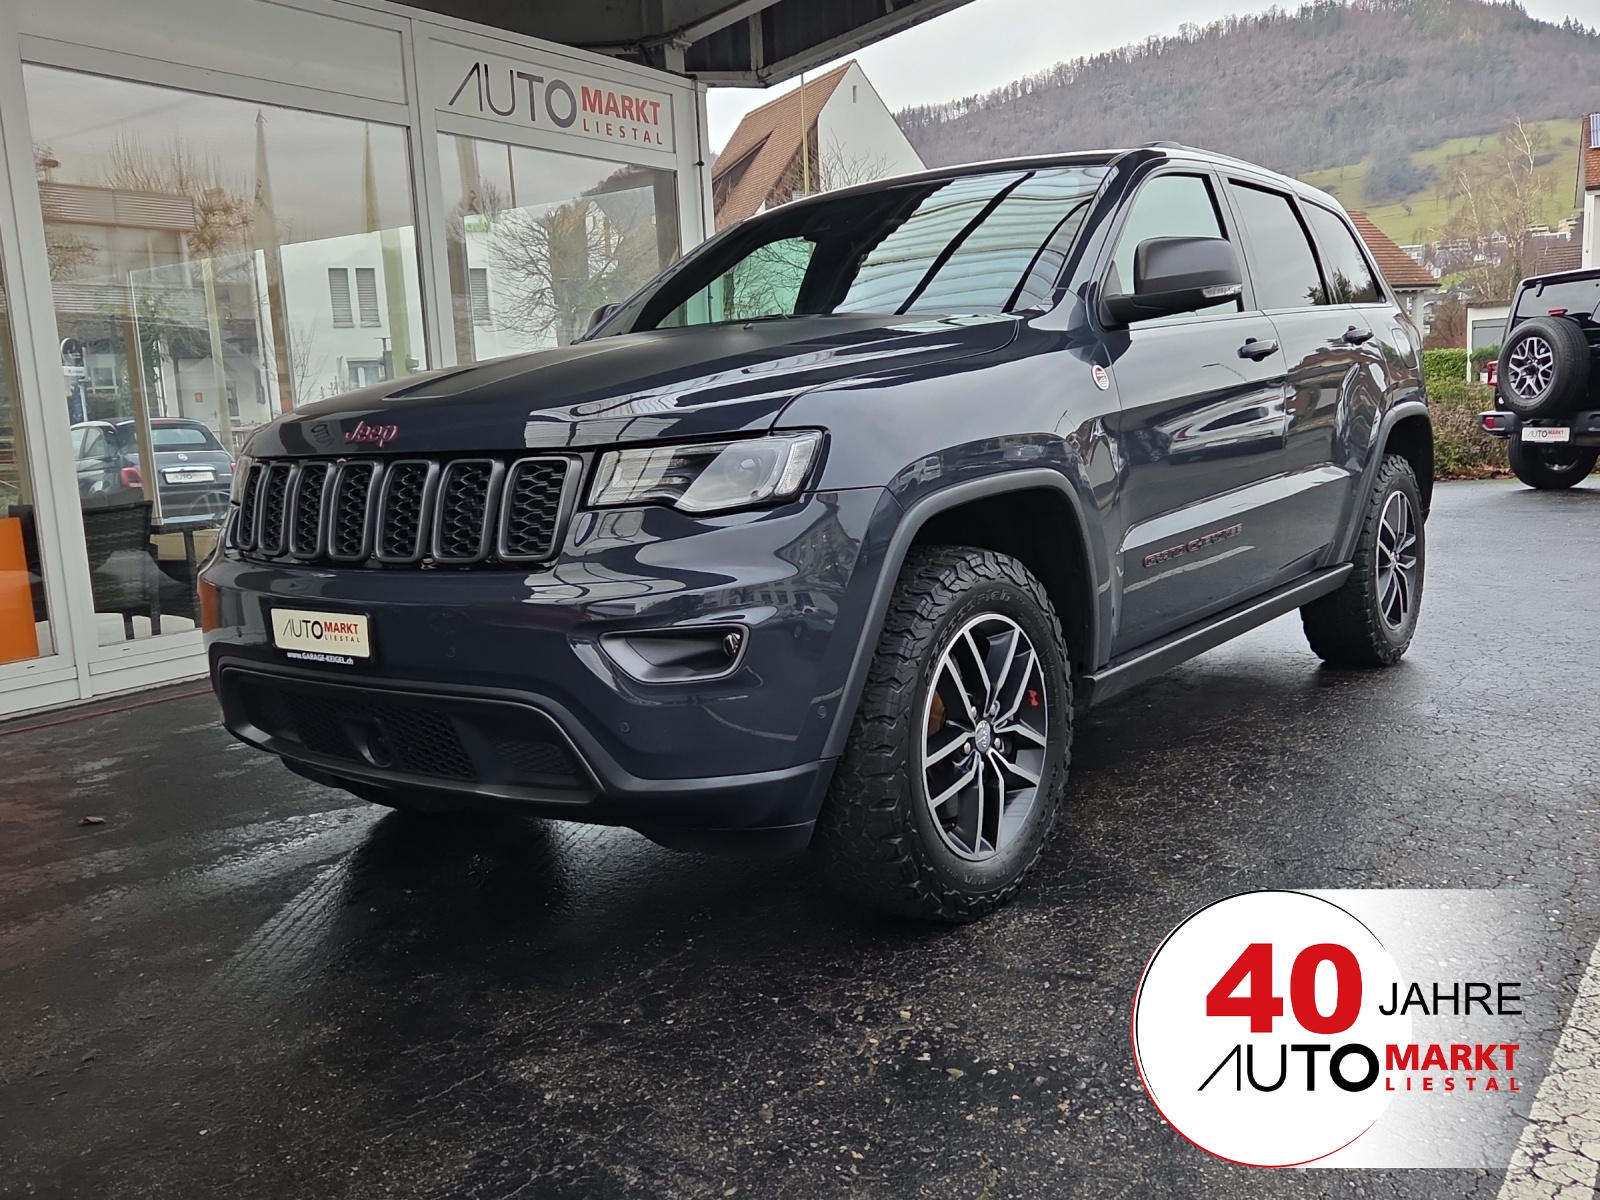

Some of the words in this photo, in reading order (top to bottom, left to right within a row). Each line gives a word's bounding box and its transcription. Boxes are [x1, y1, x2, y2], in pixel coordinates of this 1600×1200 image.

[448, 62, 577, 128] AUTO
[581, 86, 661, 126] MARKT
[583, 118, 662, 145] LIESTAL
[345, 420, 397, 447] Jeep
[283, 618, 324, 640] AUTO
[324, 621, 359, 635] MARKT
[325, 634, 360, 643] LIESTAL
